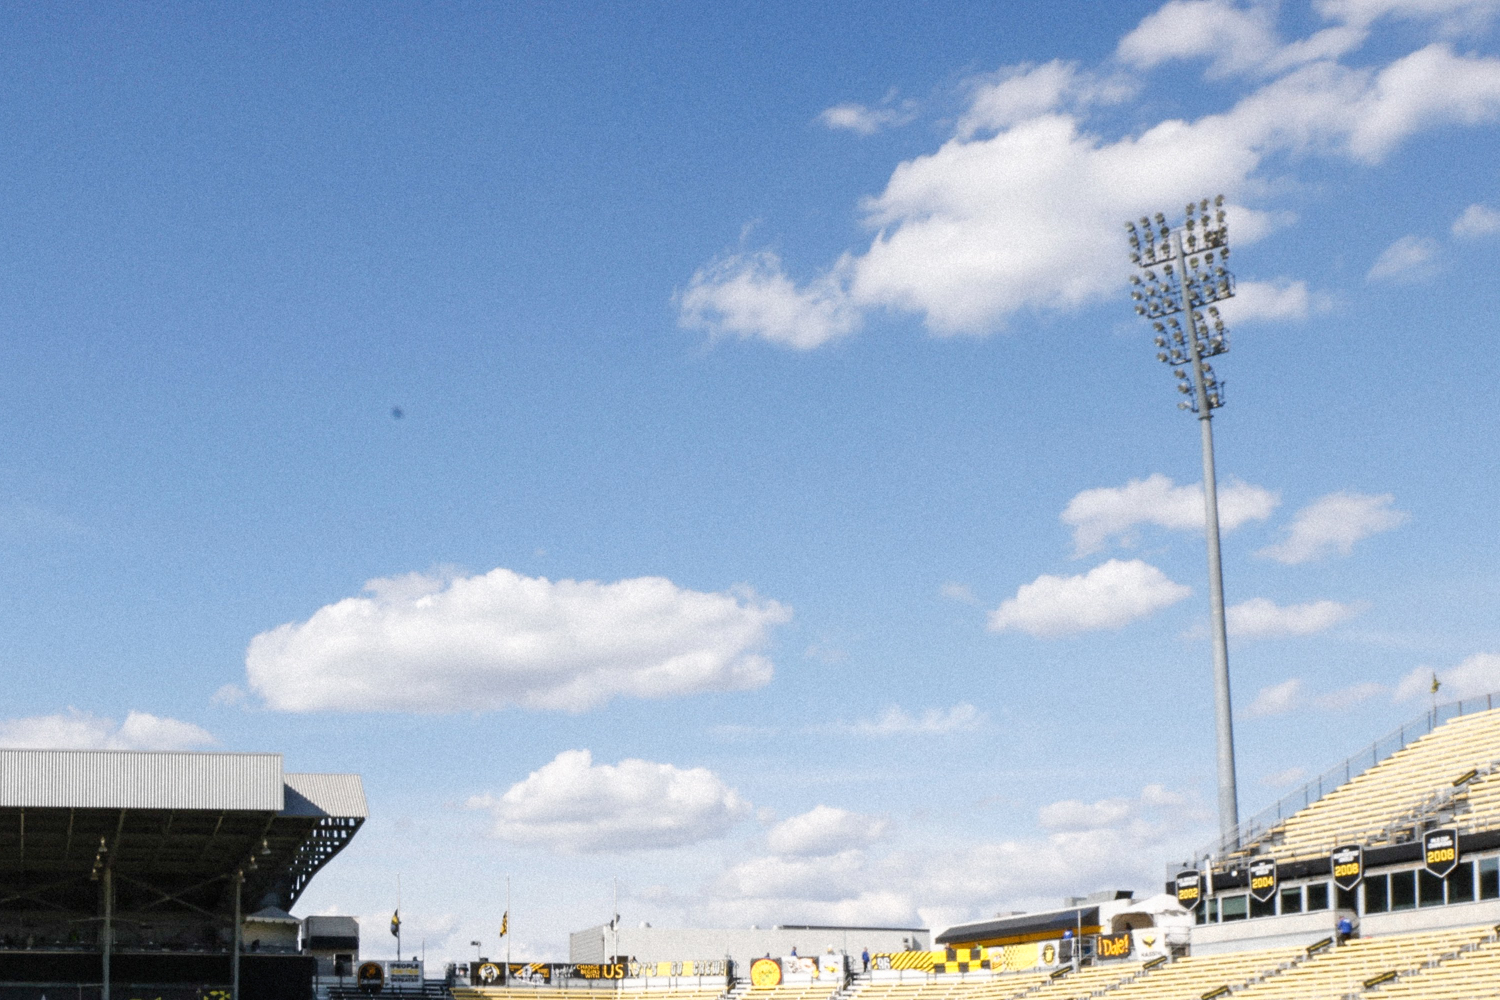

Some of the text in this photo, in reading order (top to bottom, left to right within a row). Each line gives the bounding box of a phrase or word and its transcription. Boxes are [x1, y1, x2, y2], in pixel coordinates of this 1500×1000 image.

[1427, 848, 1455, 863] 2008
[1334, 863, 1359, 877] 2008
[1252, 876, 1274, 889] 2004
[1179, 887, 1199, 900] 2002
[603, 963, 624, 979] US
